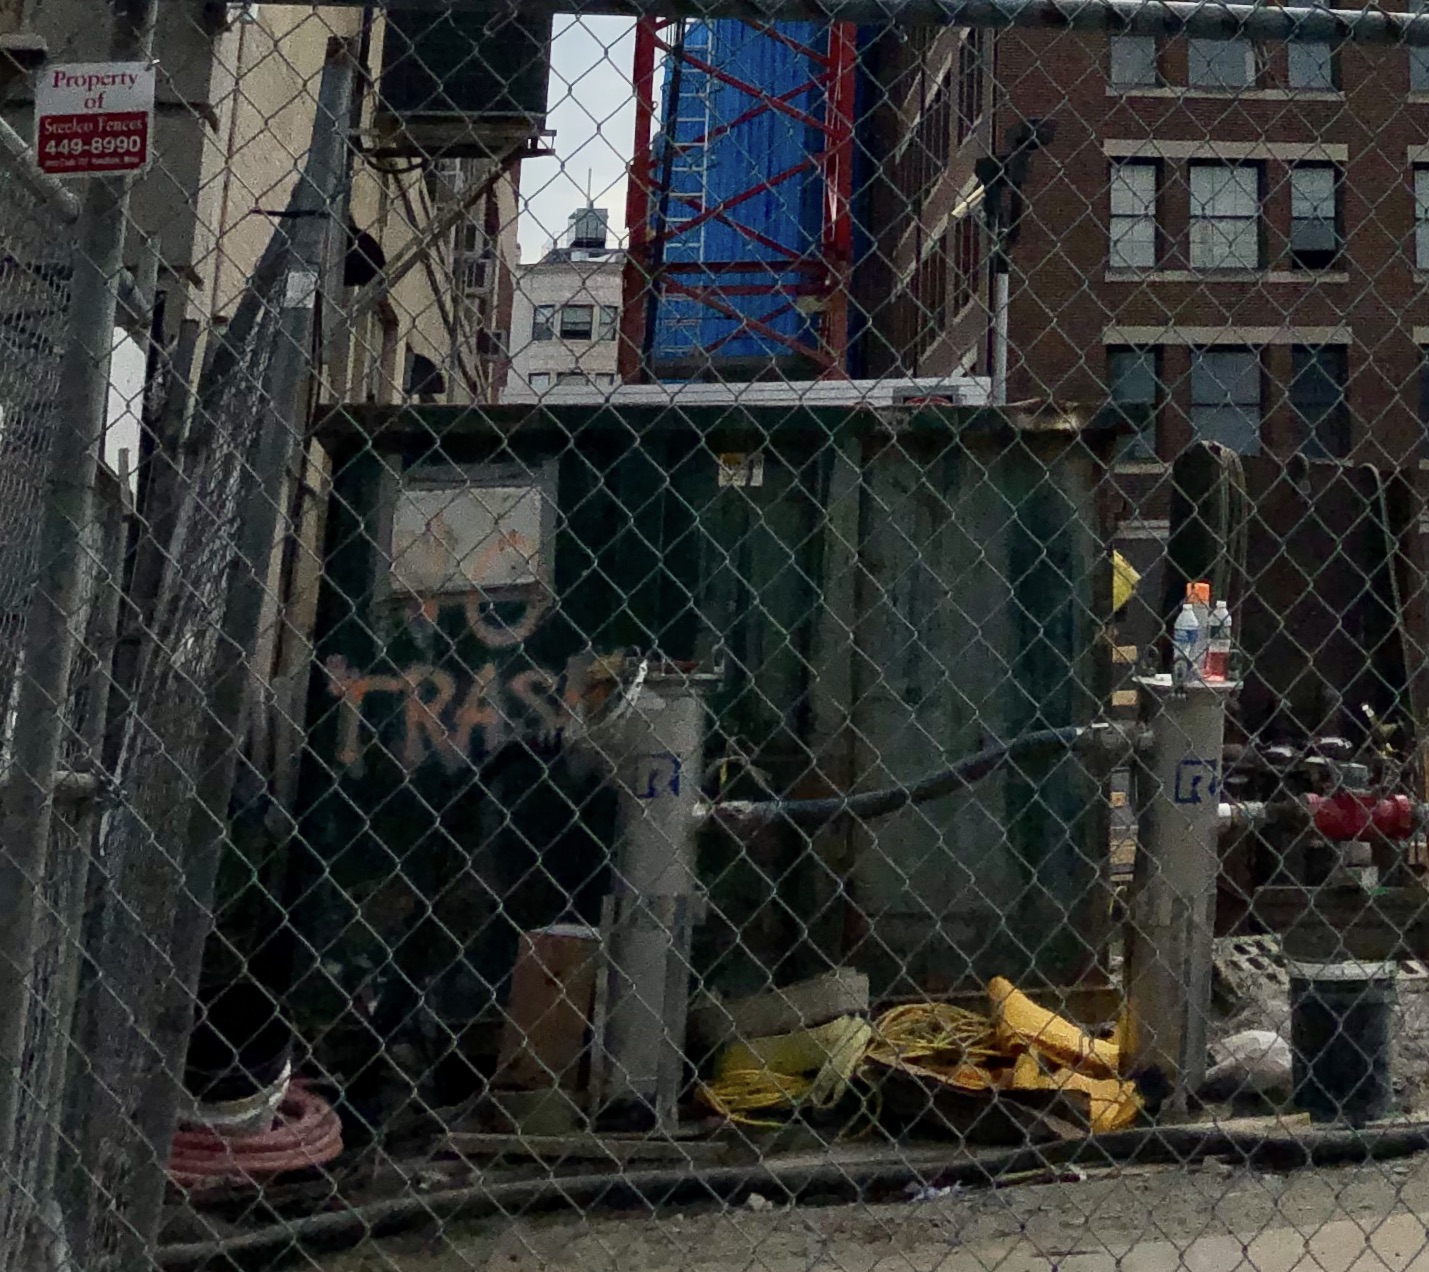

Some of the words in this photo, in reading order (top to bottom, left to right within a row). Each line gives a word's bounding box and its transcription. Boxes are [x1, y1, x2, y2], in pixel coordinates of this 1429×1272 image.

[53, 70, 138, 91] Property
[84, 90, 107, 109] of
[97, 116, 143, 132] Fences
[45, 135, 141, 156] 449-8990
